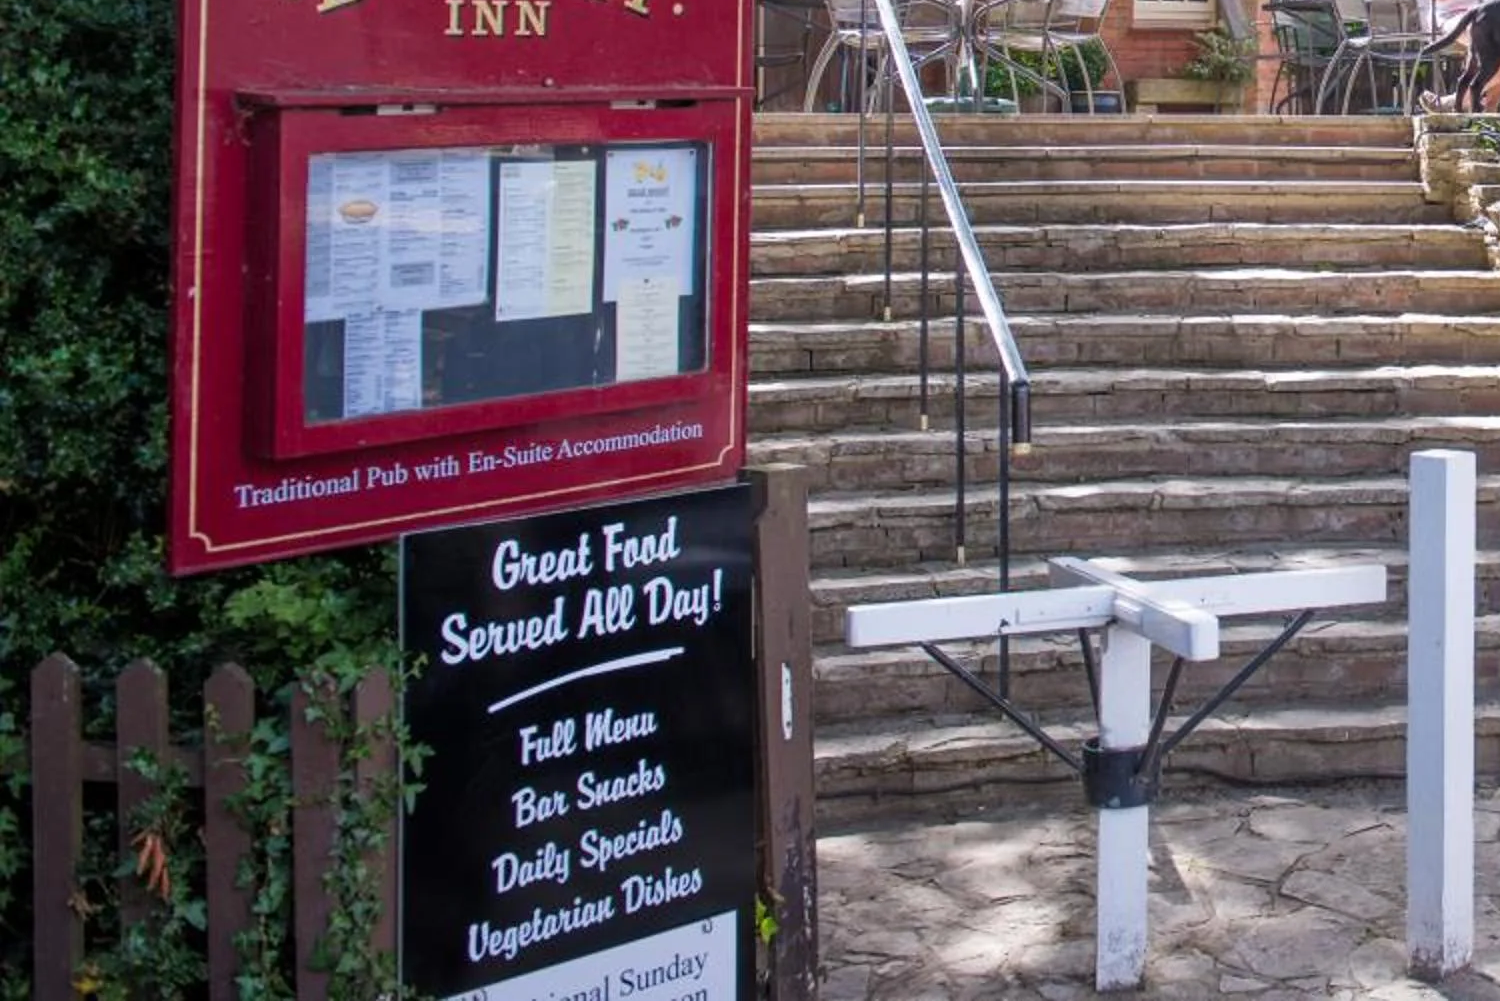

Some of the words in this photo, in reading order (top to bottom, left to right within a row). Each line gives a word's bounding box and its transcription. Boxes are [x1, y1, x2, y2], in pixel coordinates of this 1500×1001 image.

[234, 468, 361, 509] Traditional
[366, 462, 409, 489] Pub
[414, 454, 460, 481] with
[467, 442, 554, 473] En-Suite
[556, 420, 704, 460] Accommodation
[492, 532, 594, 591] Great
[602, 515, 682, 572] Food
[440, 595, 570, 666] Served
[577, 583, 637, 639] All
[643, 567, 723, 626] Day!
[519, 717, 578, 766] Full
[585, 707, 659, 752] Menu
[511, 786, 570, 829] Bar
[576, 758, 665, 810] Snacks
[492, 842, 570, 894] Daily
[579, 809, 683, 872] Specials
[468, 896, 616, 963] Vegetarian
[620, 866, 703, 915] Dishes
[619, 952, 708, 997] Sunday
